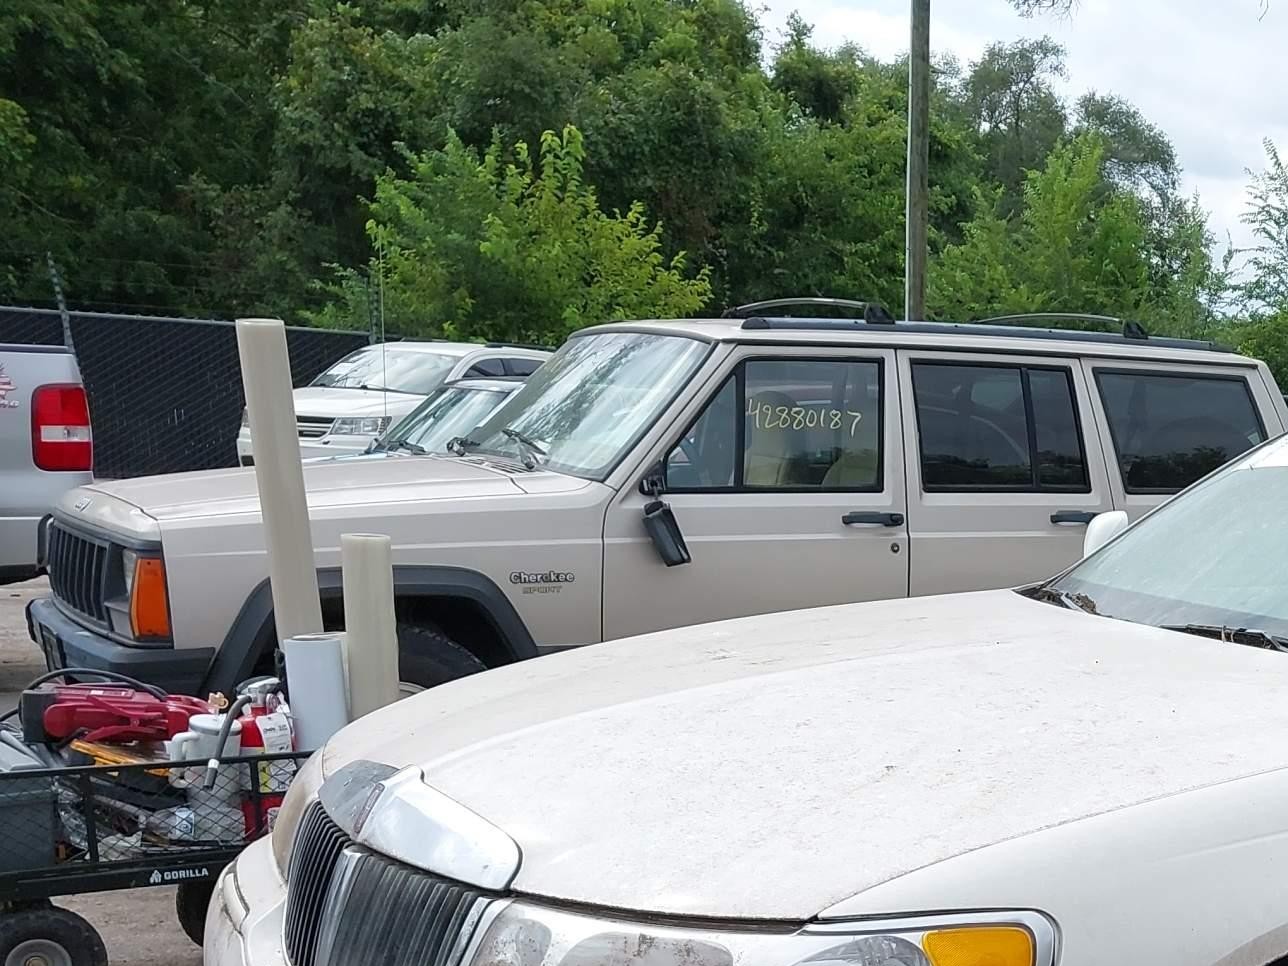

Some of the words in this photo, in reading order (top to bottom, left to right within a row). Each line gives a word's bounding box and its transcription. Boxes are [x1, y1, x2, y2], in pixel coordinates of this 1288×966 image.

[748, 398, 862, 438] 42880187
[509, 570, 575, 584] Cherokee
[163, 867, 209, 881] GORILLA
